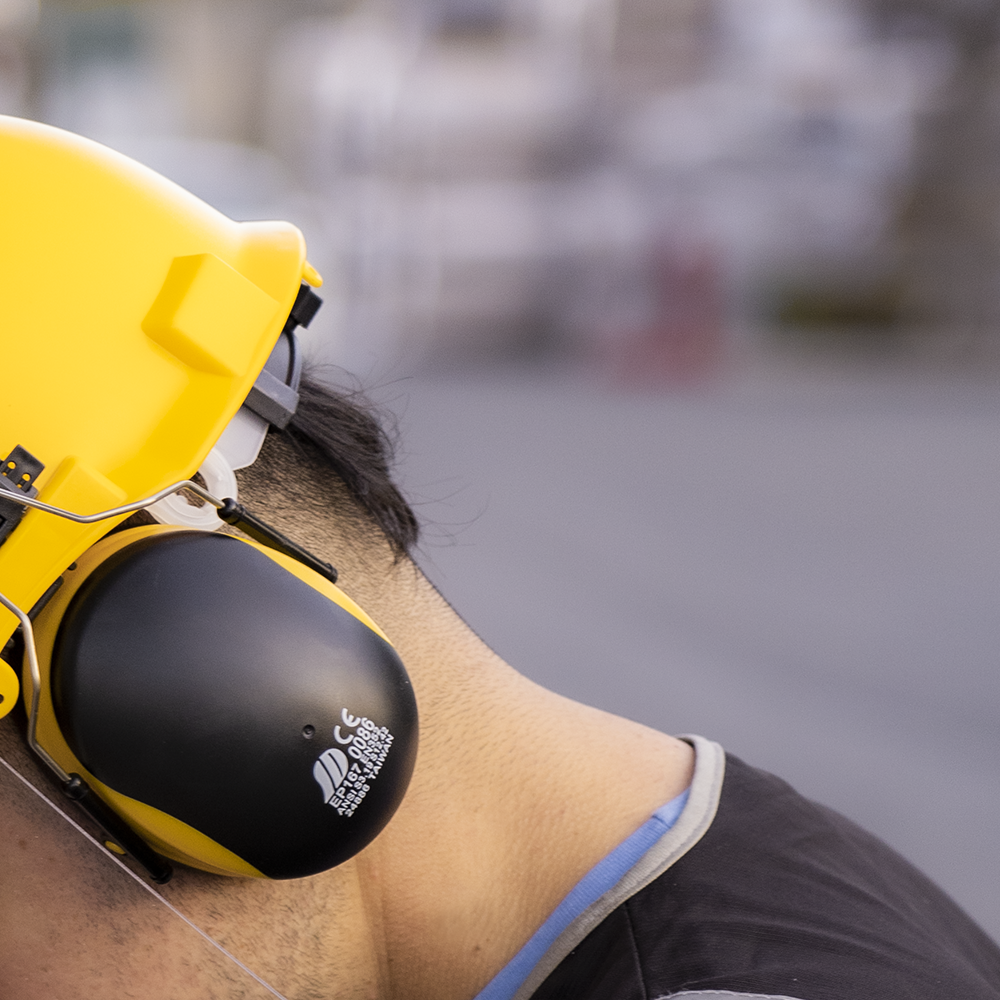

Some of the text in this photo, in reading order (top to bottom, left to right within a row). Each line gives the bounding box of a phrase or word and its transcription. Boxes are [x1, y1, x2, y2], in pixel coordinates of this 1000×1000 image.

[347, 717, 376, 760] 0086
[366, 733, 395, 780] TAIWAN
[329, 762, 362, 808] EP167
[337, 789, 358, 816] ANSI
